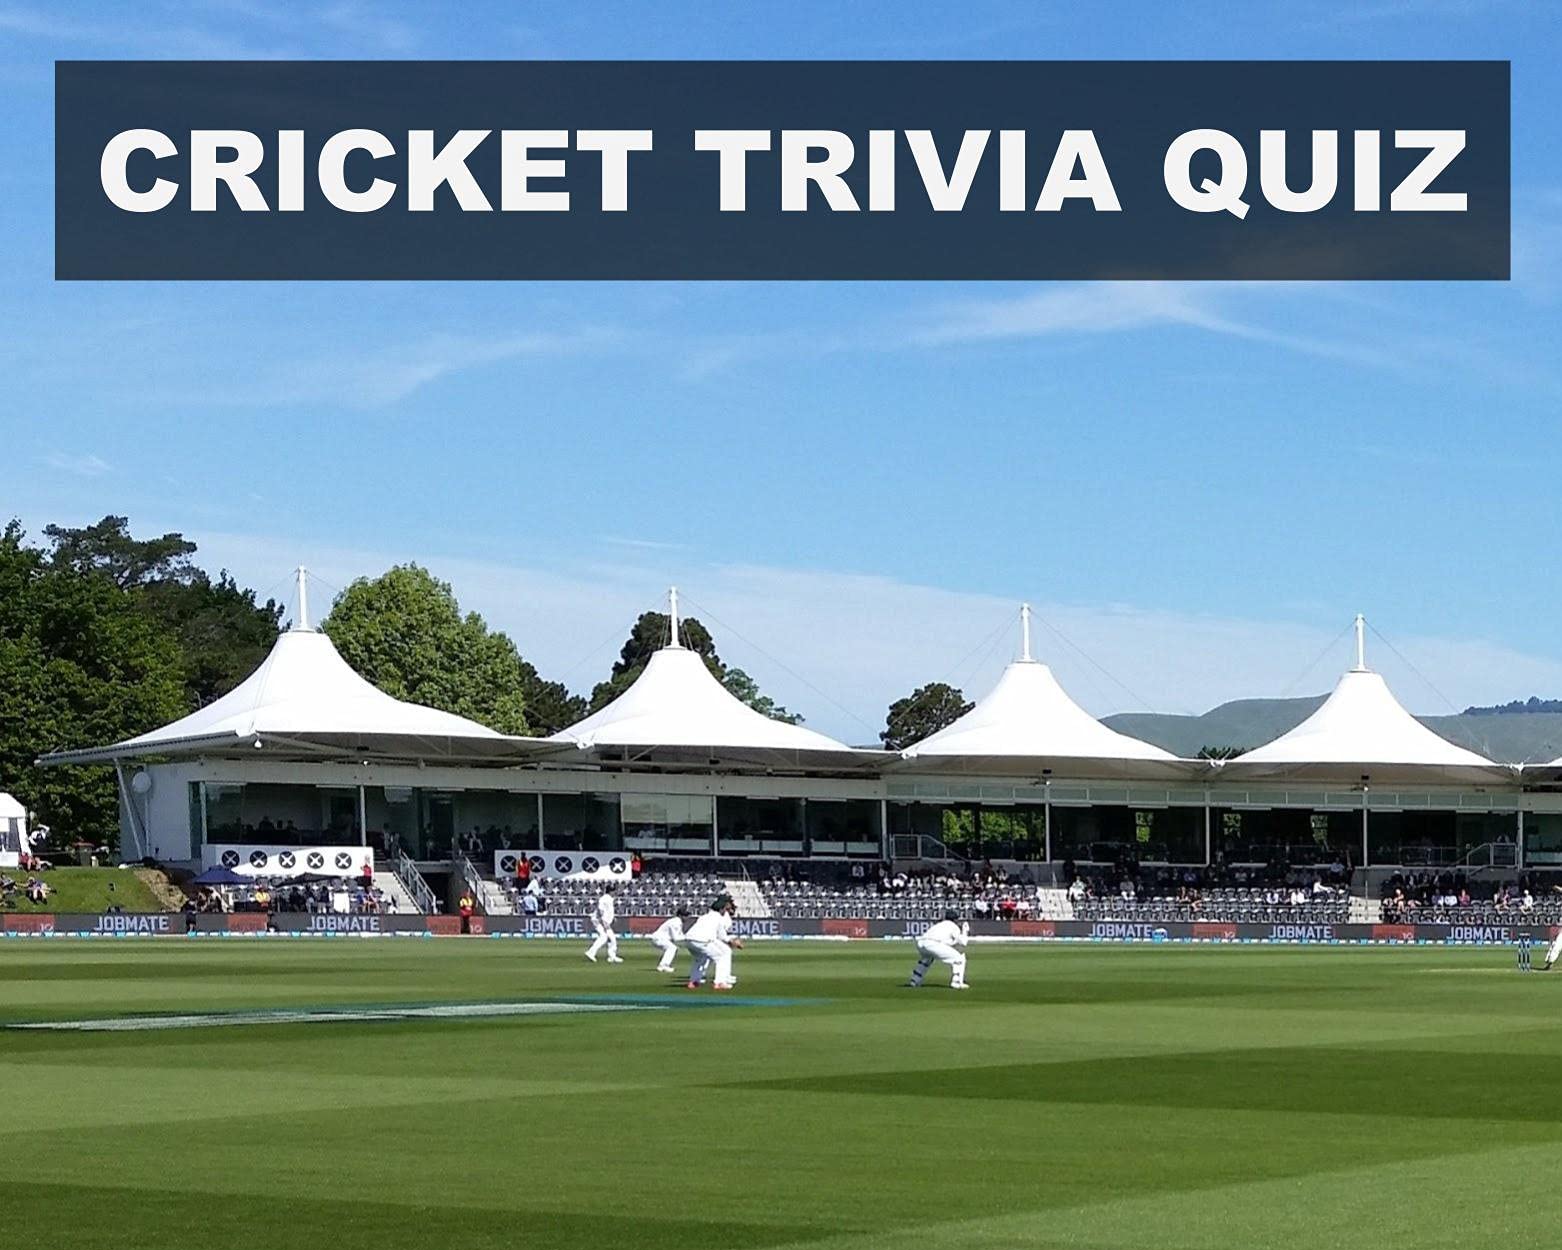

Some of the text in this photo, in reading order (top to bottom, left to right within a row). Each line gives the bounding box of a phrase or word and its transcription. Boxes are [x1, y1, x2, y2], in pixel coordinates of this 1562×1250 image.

[94, 916, 169, 931] JOBMATE
[307, 916, 380, 931] JOBMATE
[727, 920, 780, 934] BMATE
[1088, 924, 1153, 938] JOBMATE
[1269, 926, 1332, 939] JOBMATE
[1447, 927, 1509, 940] JOBMATE
